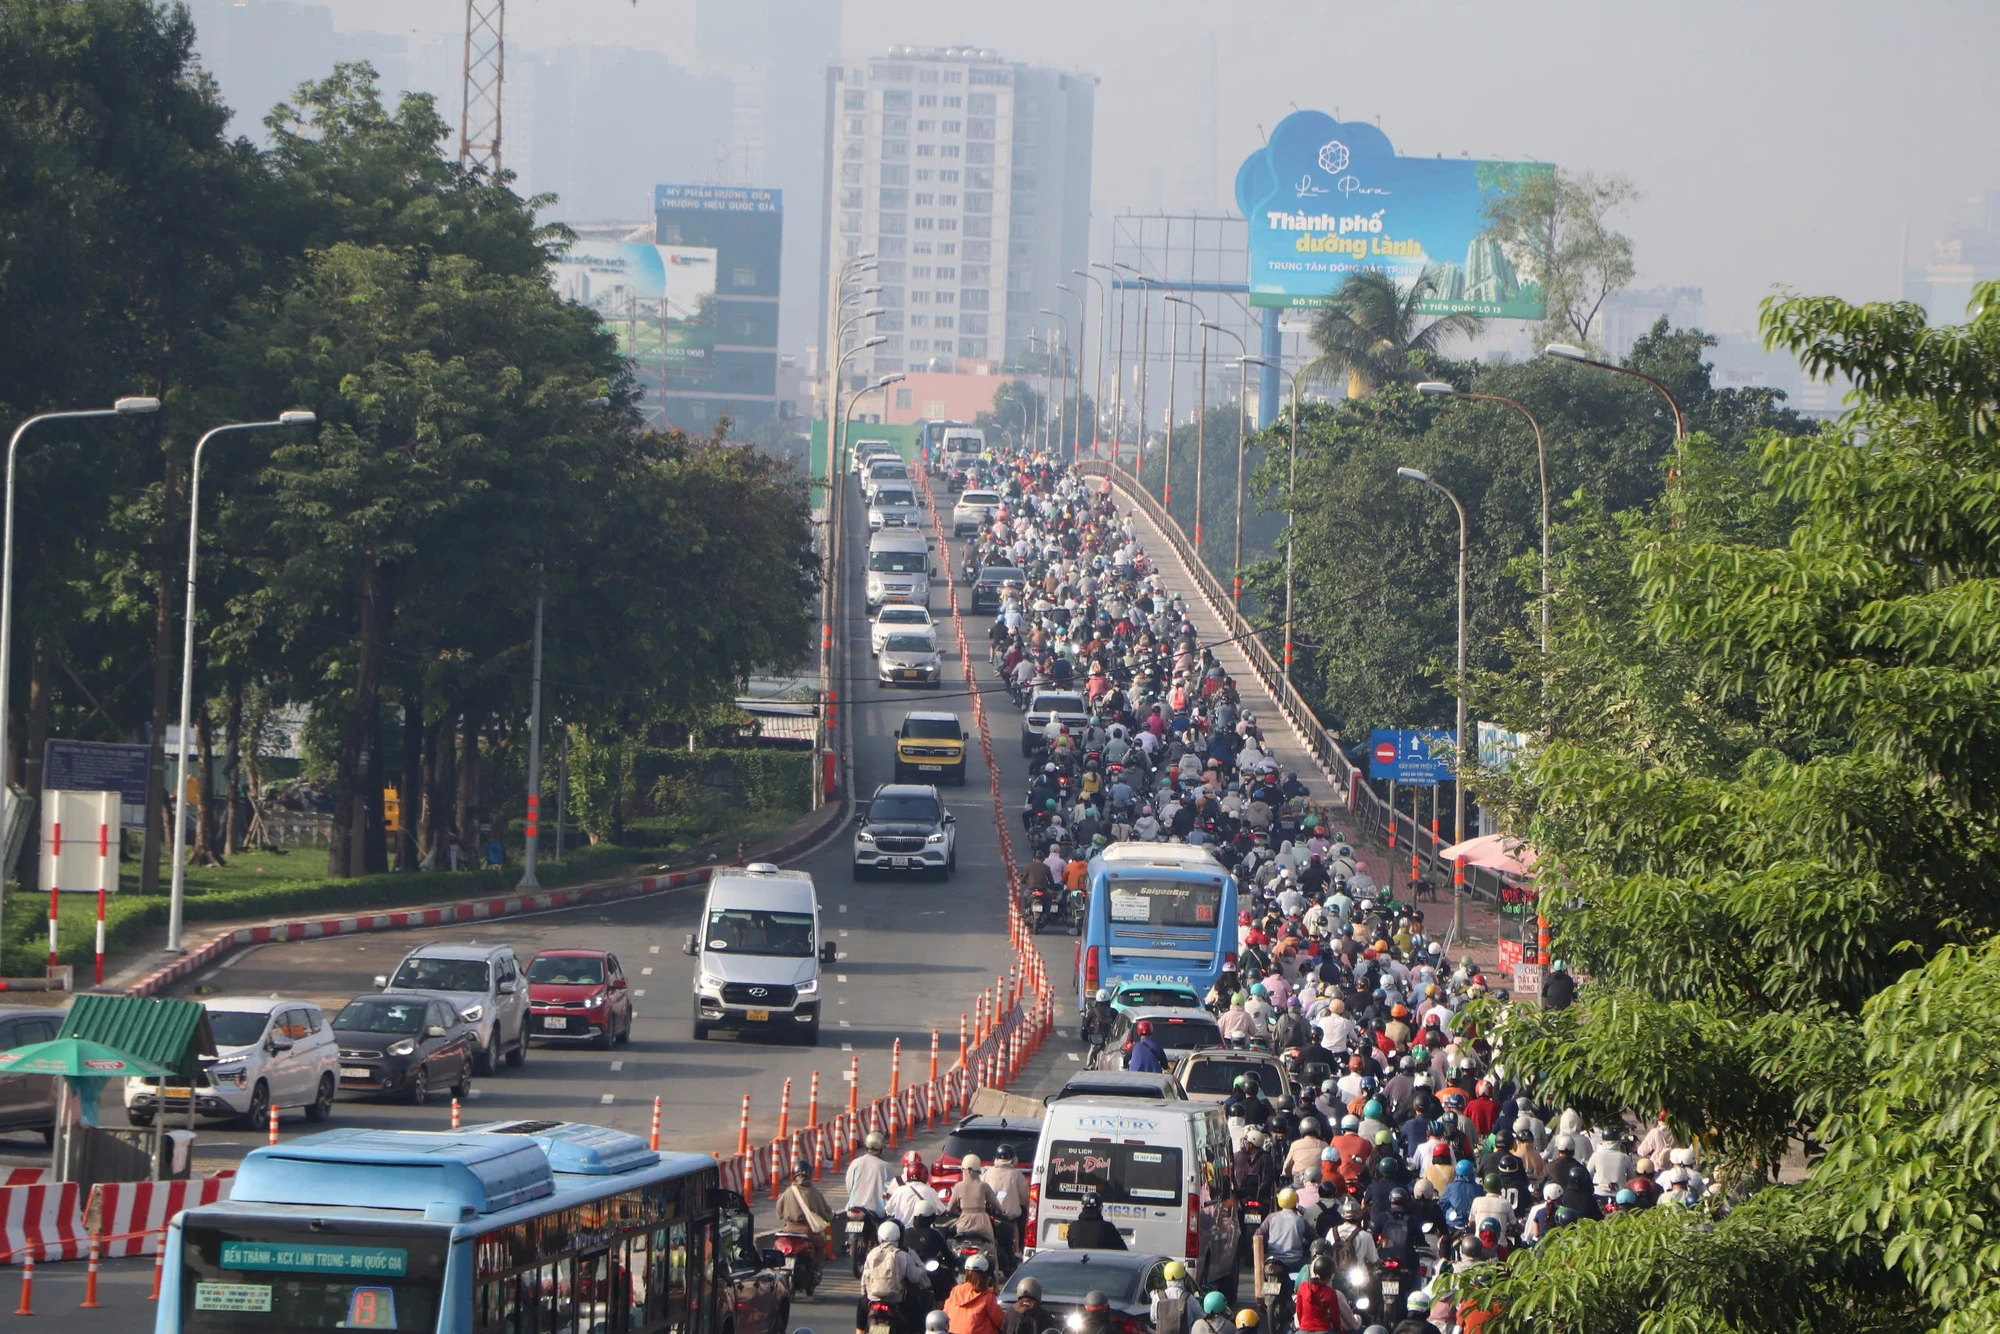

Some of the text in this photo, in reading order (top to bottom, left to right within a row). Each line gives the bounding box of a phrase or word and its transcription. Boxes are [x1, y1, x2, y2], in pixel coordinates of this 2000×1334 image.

[1295, 174, 1392, 200] La Pura
[759, 202, 775, 212] GIA
[1267, 209, 1385, 234] Thành phố
[1296, 232, 1367, 259] dưỡng
[1268, 261, 1302, 271] TRUNG
[1306, 261, 1327, 271] TÂM
[1140, 887, 1190, 897] SaigonBus
[1198, 907, 1211, 919] 93
[1079, 1118, 1158, 1130] LUXURY
[224, 1245, 241, 1263] BẾN
[243, 1247, 271, 1264] THÀNH
[277, 1252, 293, 1265] KCX
[296, 1253, 314, 1266] LINH
[317, 1253, 343, 1267] TRUNG
[350, 1255, 362, 1268] ĐH
[364, 1251, 387, 1270] QUỐC
[388, 1257, 402, 1270] GIA
